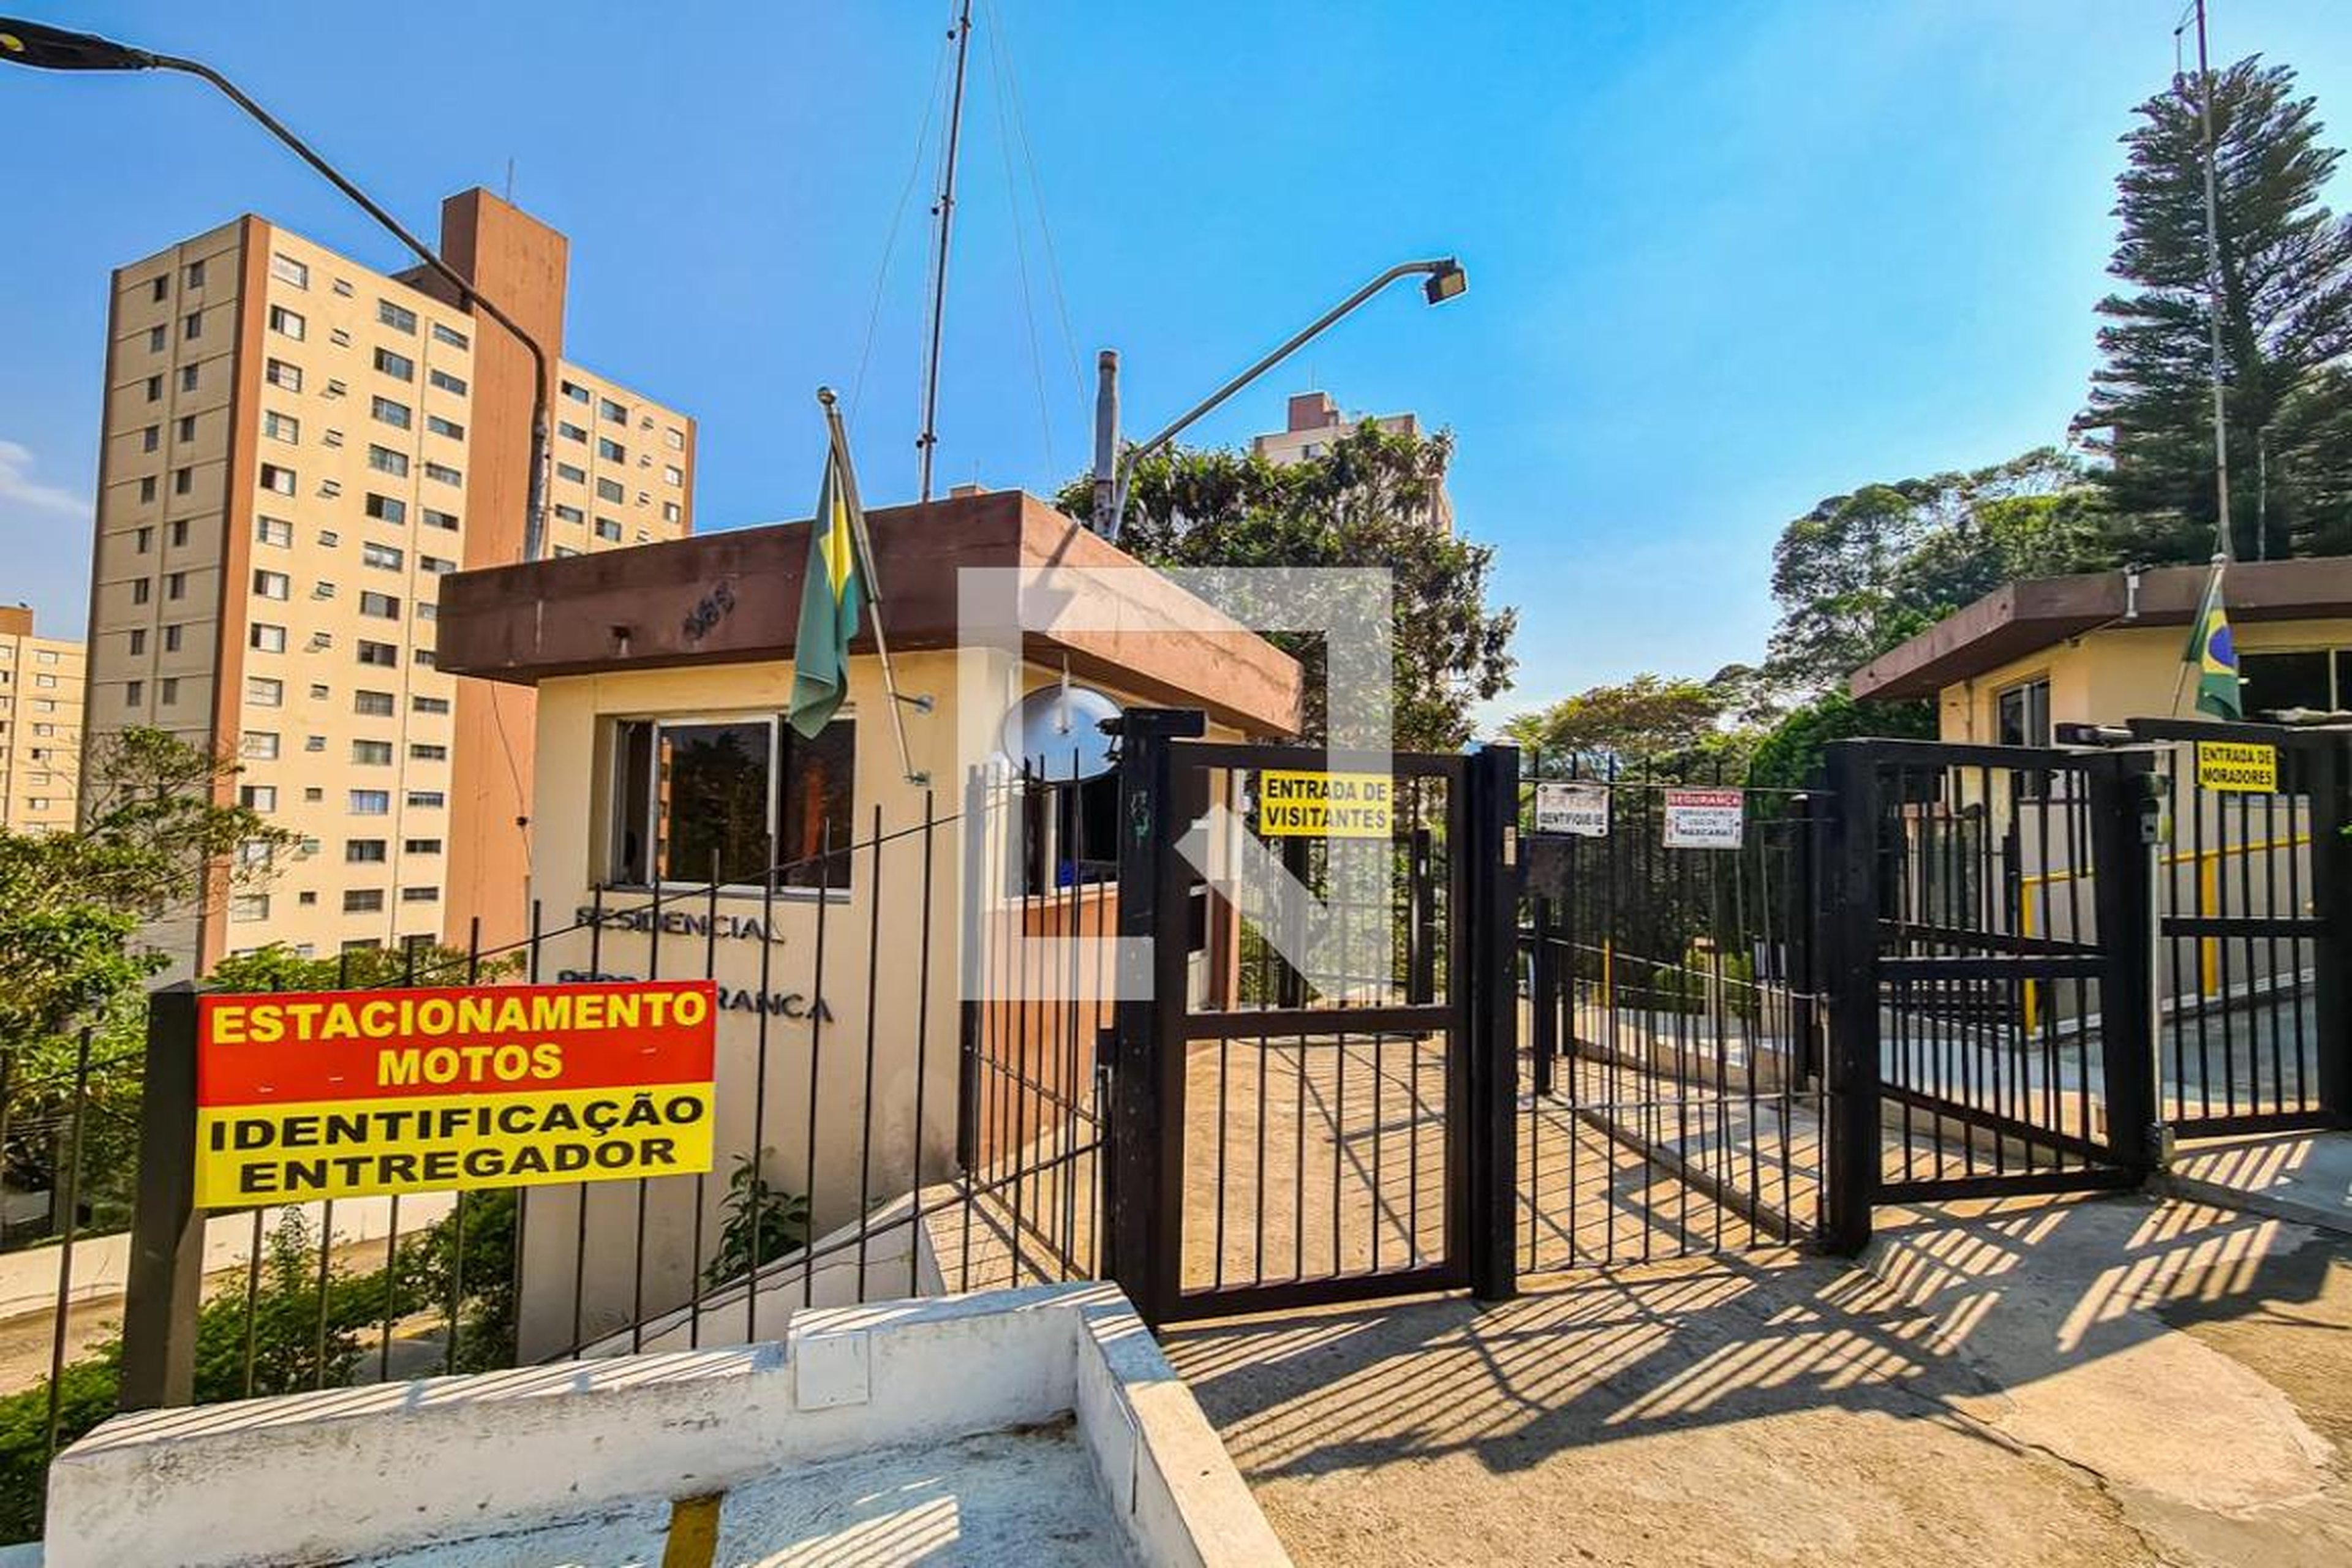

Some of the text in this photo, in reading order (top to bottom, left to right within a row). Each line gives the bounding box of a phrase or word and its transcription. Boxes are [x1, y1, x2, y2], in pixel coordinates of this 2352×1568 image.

[2203, 746, 2272, 765] ENTRADA DE
[1267, 778, 1387, 802] ENTRADA DE
[2203, 767, 2272, 785] MORADORES
[1267, 806, 1387, 829] VISITANTES
[212, 990, 706, 1044] ESTACIONAMENTO
[718, 986, 834, 1023] RANCA
[377, 1042, 562, 1086] MOTOS
[211, 1092, 704, 1151] IDENTIFICAÇÃO
[239, 1137, 676, 1194] ENTREGADOR
